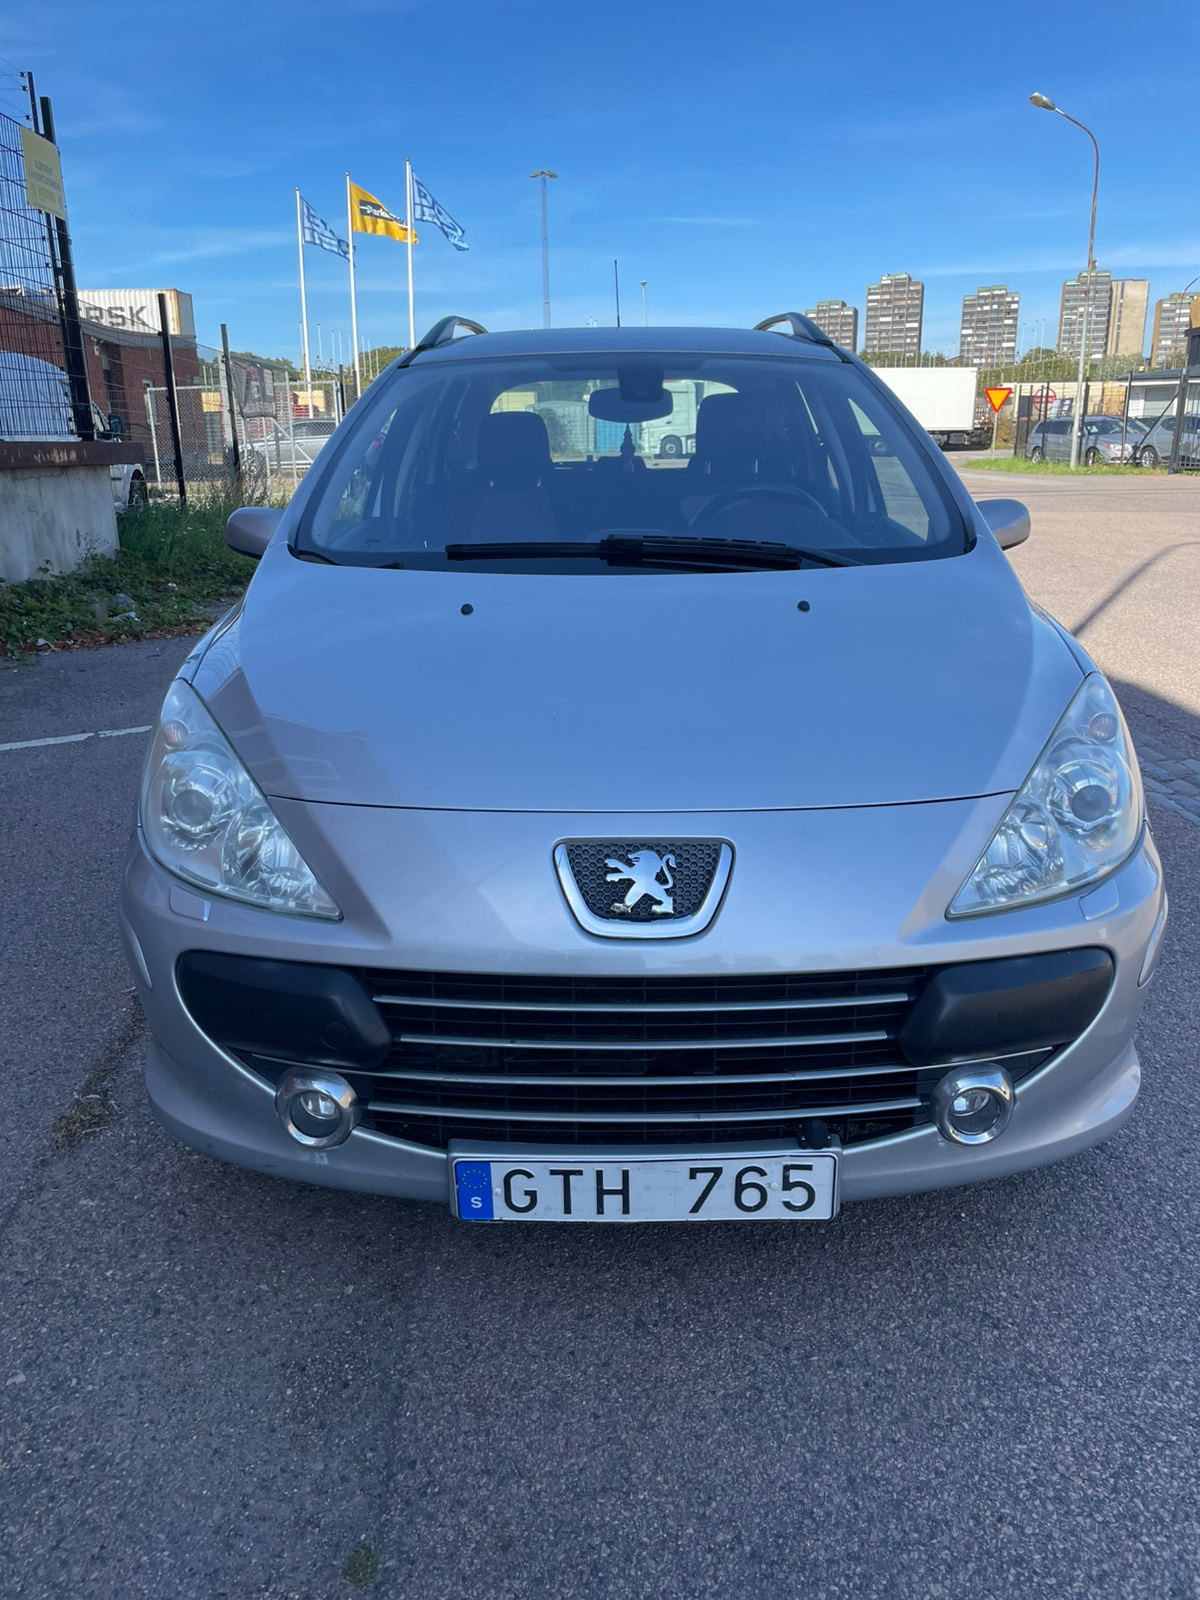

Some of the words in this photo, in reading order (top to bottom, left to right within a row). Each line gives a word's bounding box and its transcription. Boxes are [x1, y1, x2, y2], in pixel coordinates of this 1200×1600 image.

[79, 306, 148, 327] RSK
[470, 1196, 483, 1209] S
[503, 1168, 630, 1215] GTH
[689, 1164, 816, 1213] 765
